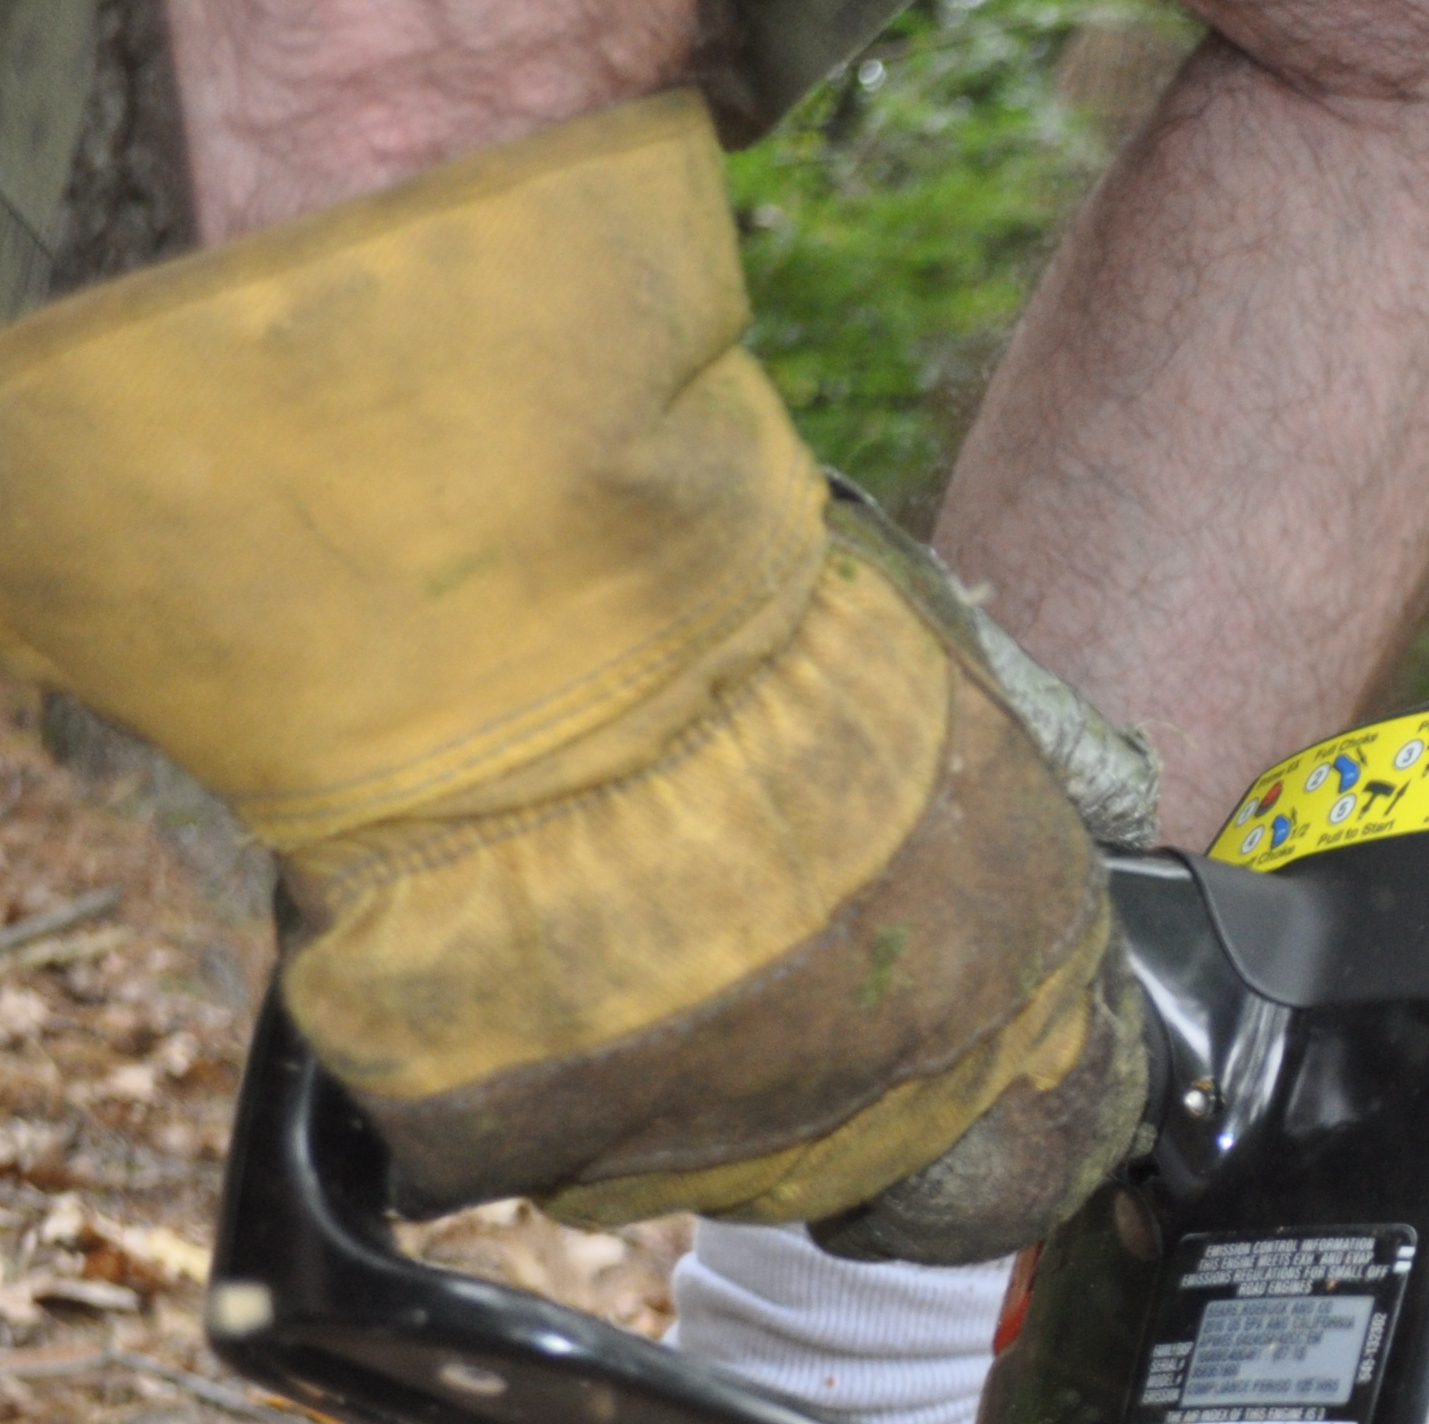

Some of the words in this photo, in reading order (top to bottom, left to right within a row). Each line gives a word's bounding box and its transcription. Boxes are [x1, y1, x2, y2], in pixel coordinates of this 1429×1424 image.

[1339, 733, 1378, 750] Choke
[1317, 829, 1342, 846] Pull
[1345, 826, 1359, 839] to
[1361, 819, 1396, 836] Start
[1205, 1242, 1251, 1258] EMISSION
[1253, 1239, 1298, 1254] CONTROL
[1301, 1237, 1375, 1251] INFORMATION
[1199, 1256, 1220, 1271] THIS
[1221, 1254, 1256, 1270] ENGINE
[1257, 1251, 1292, 1268] MEETS
[1320, 1250, 1344, 1265] AND
[1181, 1270, 1232, 1288] EMISSIONS
[1233, 1266, 1302, 1284] REGULATIONS
[1304, 1265, 1326, 1280] FOR
[1327, 1264, 1364, 1280] SMALL
[1366, 1264, 1389, 1279] OFF
[1238, 1281, 1267, 1296] ROAD
[1268, 1279, 1313, 1295] ENGINES
[1167, 1410, 1183, 1423] THE
[1201, 1409, 1229, 1422] INDEX
[1229, 1408, 1243, 1421] OF
[1245, 1408, 1267, 1421] THIS
[1268, 1408, 1304, 1421] ENGINE
